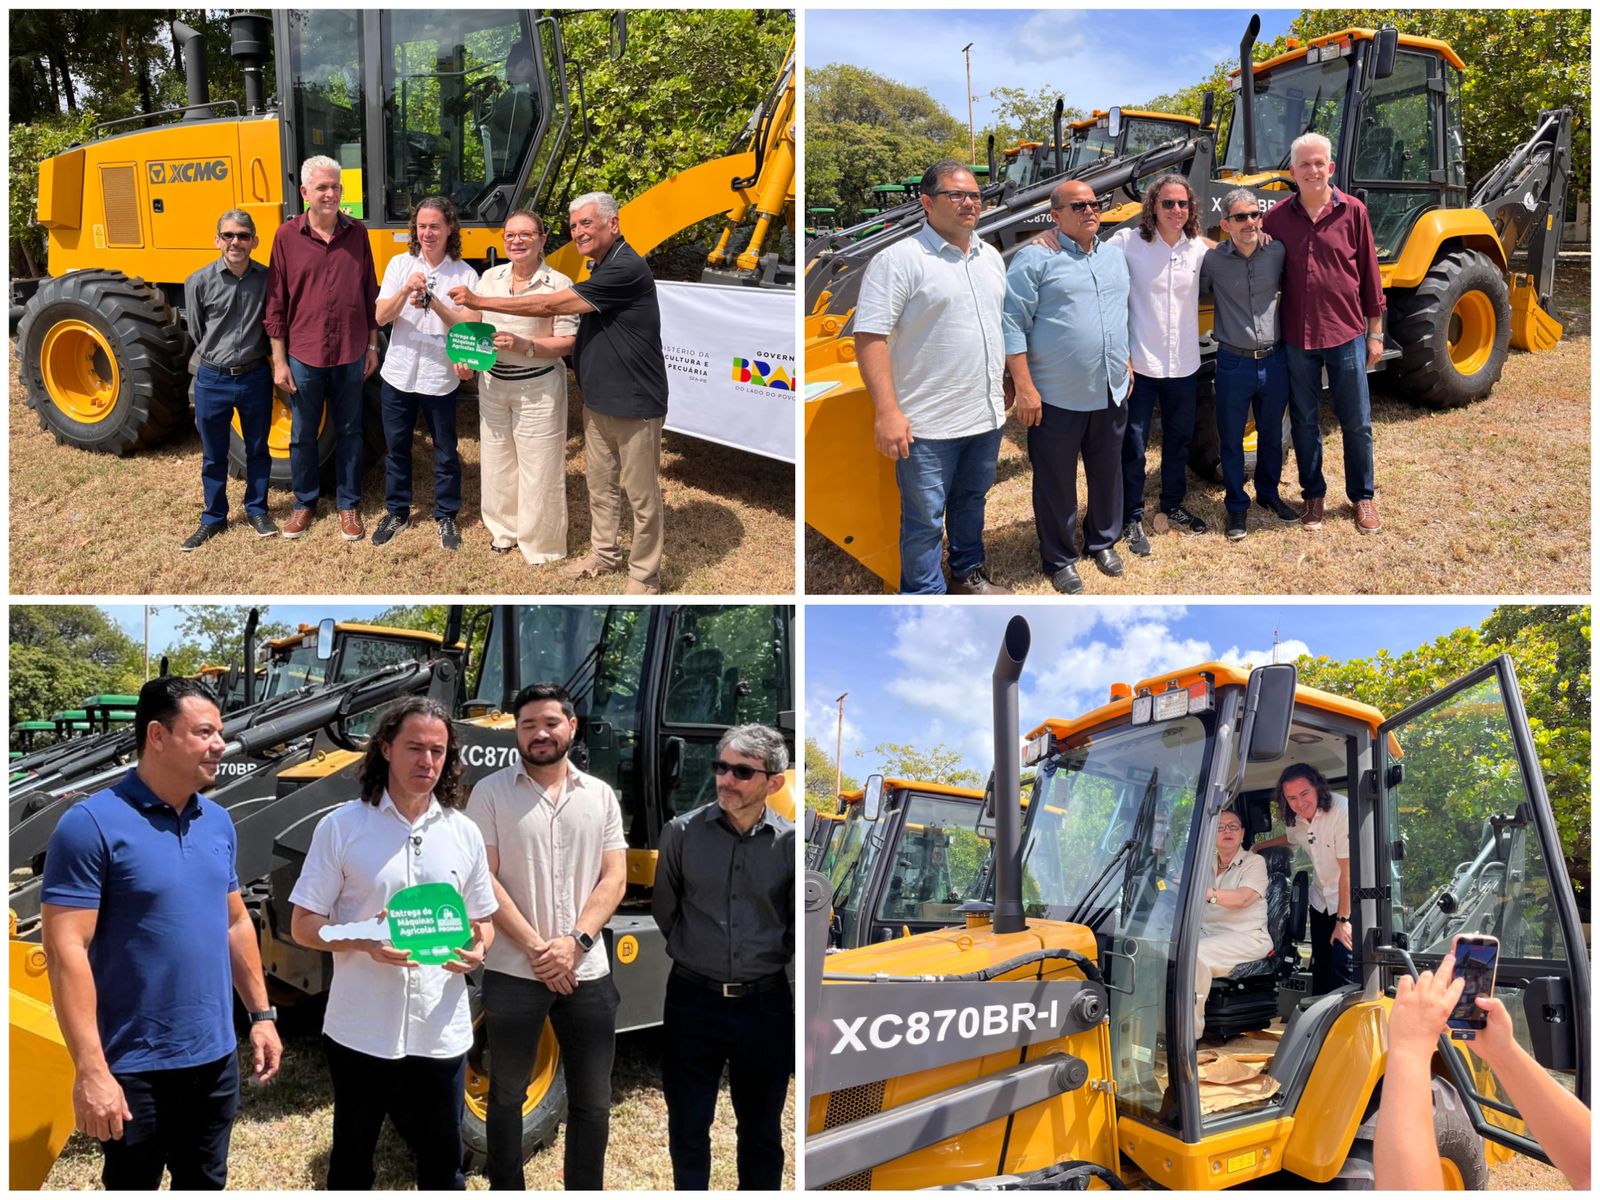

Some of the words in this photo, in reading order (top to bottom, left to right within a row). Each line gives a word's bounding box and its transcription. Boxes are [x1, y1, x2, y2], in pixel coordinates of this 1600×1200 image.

[168, 160, 228, 184] XCMG
[664, 354, 701, 366] CULTURA
[698, 351, 710, 359] DA
[756, 350, 795, 362] GOVERN
[668, 363, 708, 377] PECUÁRIA
[746, 388, 764, 396] LADO
[390, 909, 421, 918] Entrega
[422, 906, 432, 915] de
[397, 917, 434, 928] Máquinas
[400, 926, 436, 936] Agrícolas
[829, 999, 1059, 1056] XC870BR-I
